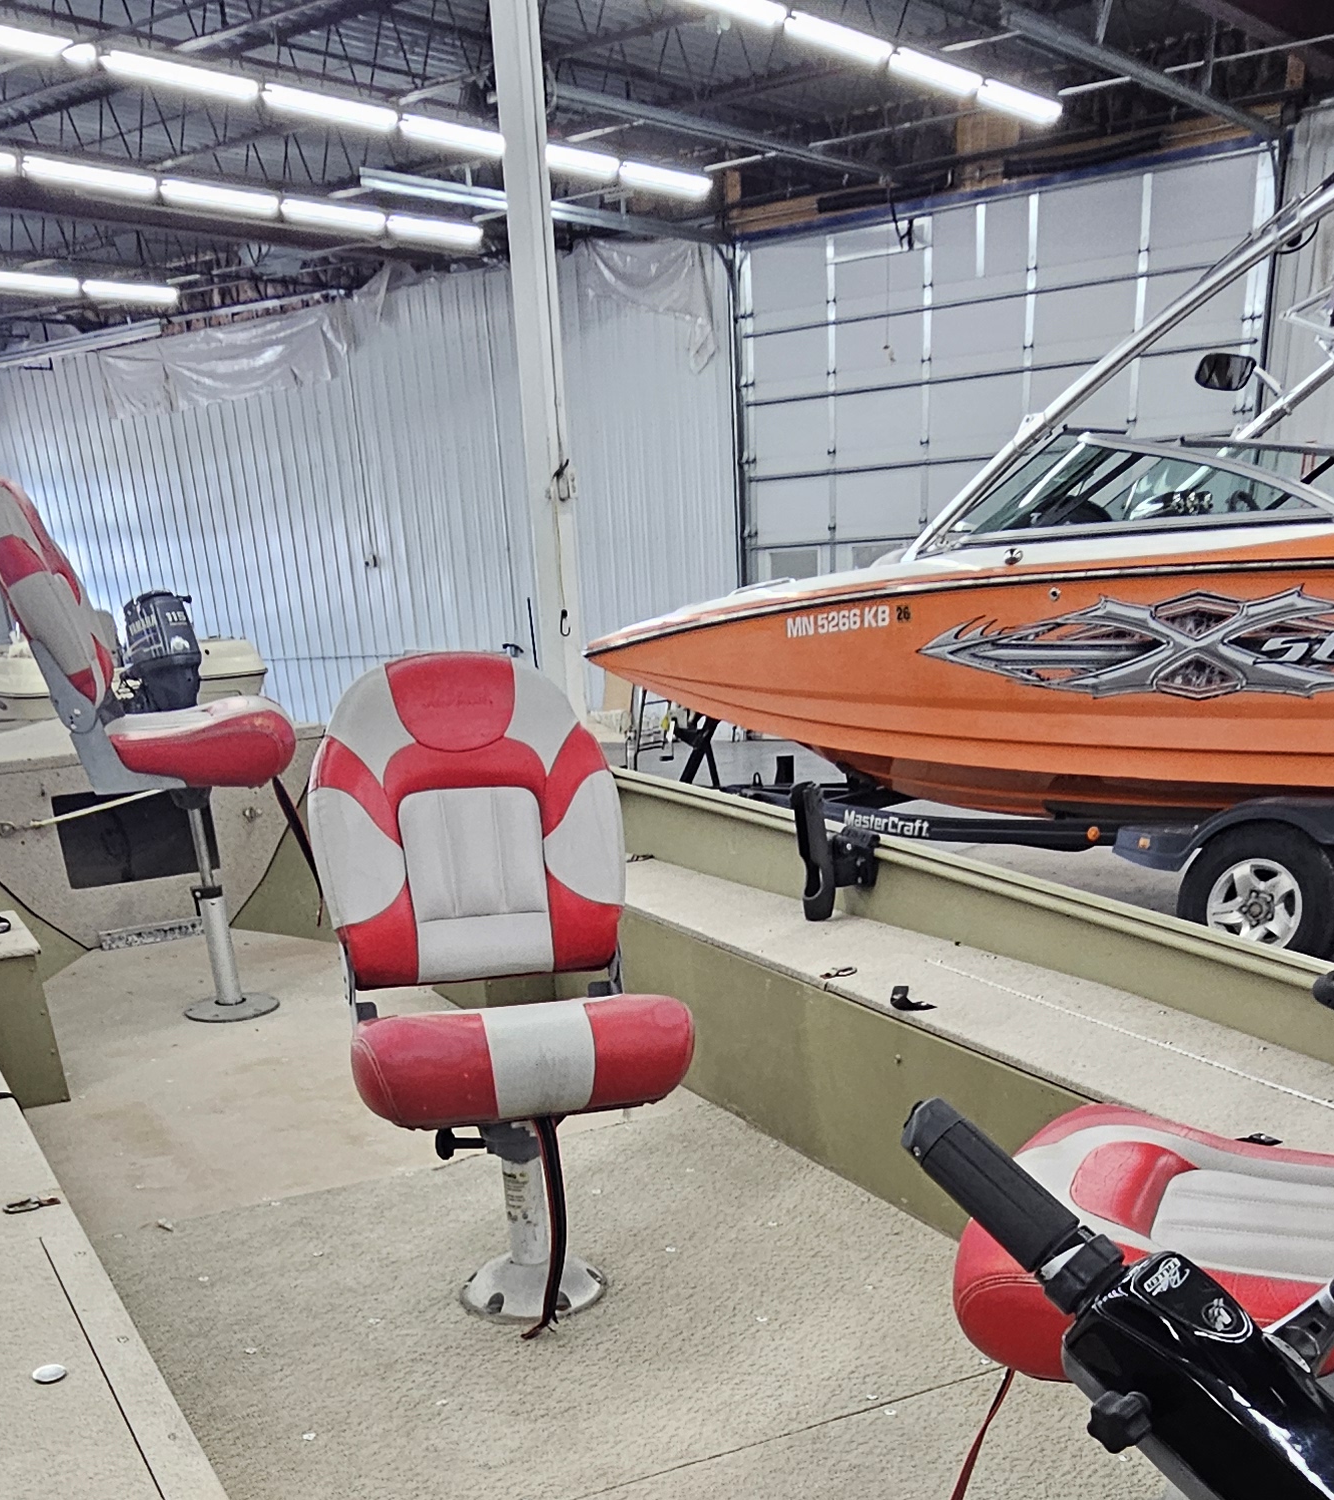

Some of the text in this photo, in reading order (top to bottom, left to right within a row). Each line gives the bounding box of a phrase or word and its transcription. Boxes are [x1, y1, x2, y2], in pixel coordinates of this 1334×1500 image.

[786, 605, 911, 638] MN 5266 KB 26
[844, 809, 929, 837] MasterCraft
